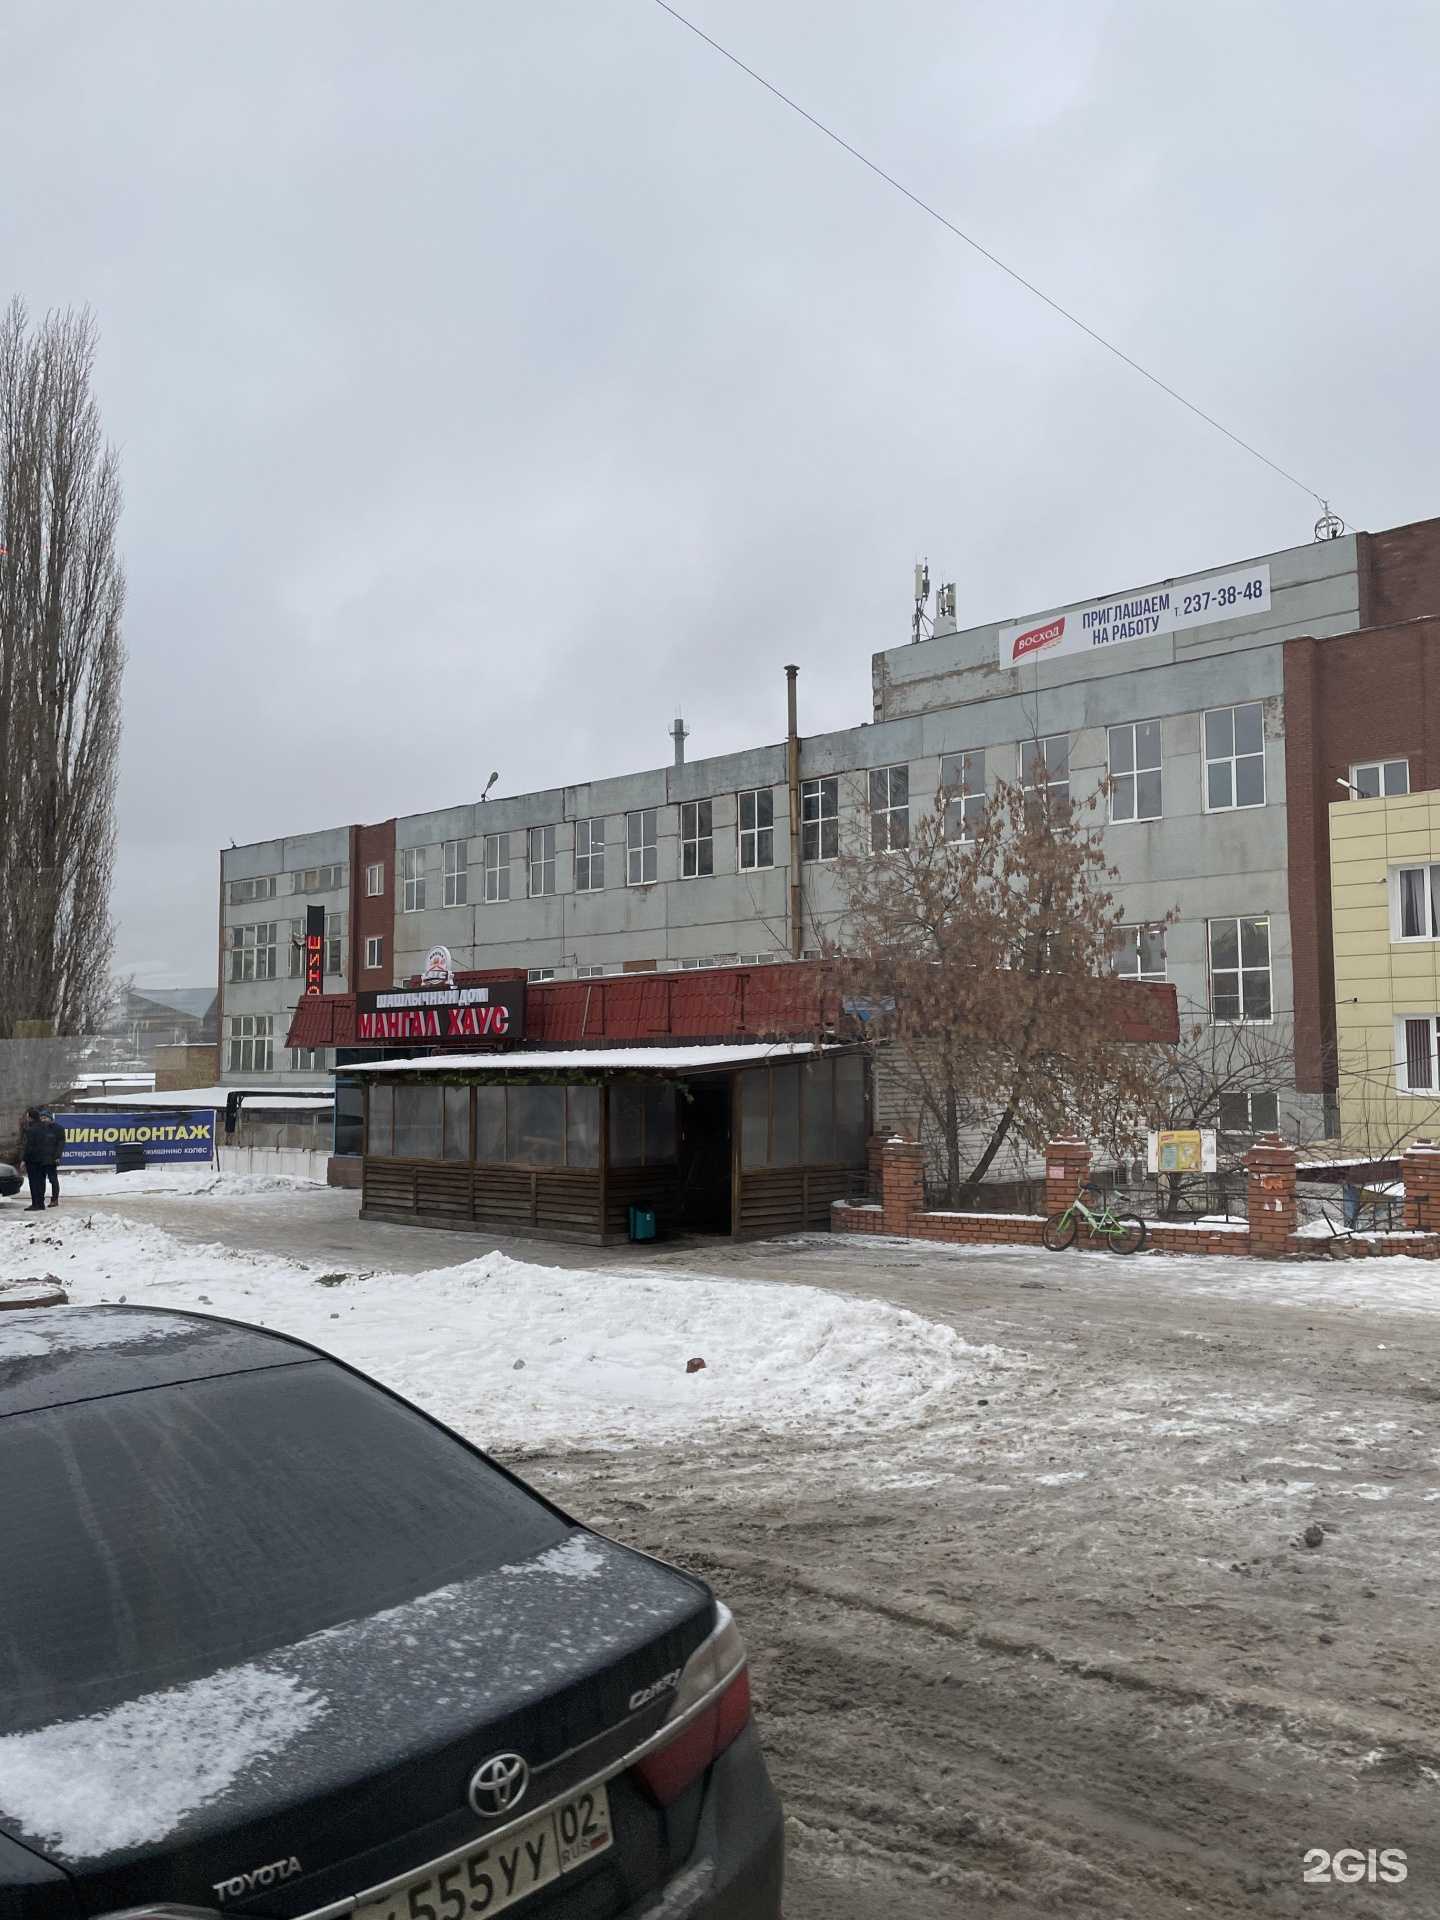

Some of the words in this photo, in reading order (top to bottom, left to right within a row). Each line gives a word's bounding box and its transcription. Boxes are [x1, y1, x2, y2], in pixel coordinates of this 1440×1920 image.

[1082, 593, 1170, 629] ПРИГЛАШАЕМ
[1184, 580, 1263, 615] 237-38-48
[1018, 626, 1060, 650] ВОСХОД
[1093, 628, 1109, 645] НА
[1112, 616, 1160, 642] РАБОТУ
[359, 1010, 441, 1039] МАНГАЛ
[448, 1006, 510, 1036] ХАУС
[560, 1793, 597, 1843] 02
[212, 1856, 303, 1902] TOYOTA
